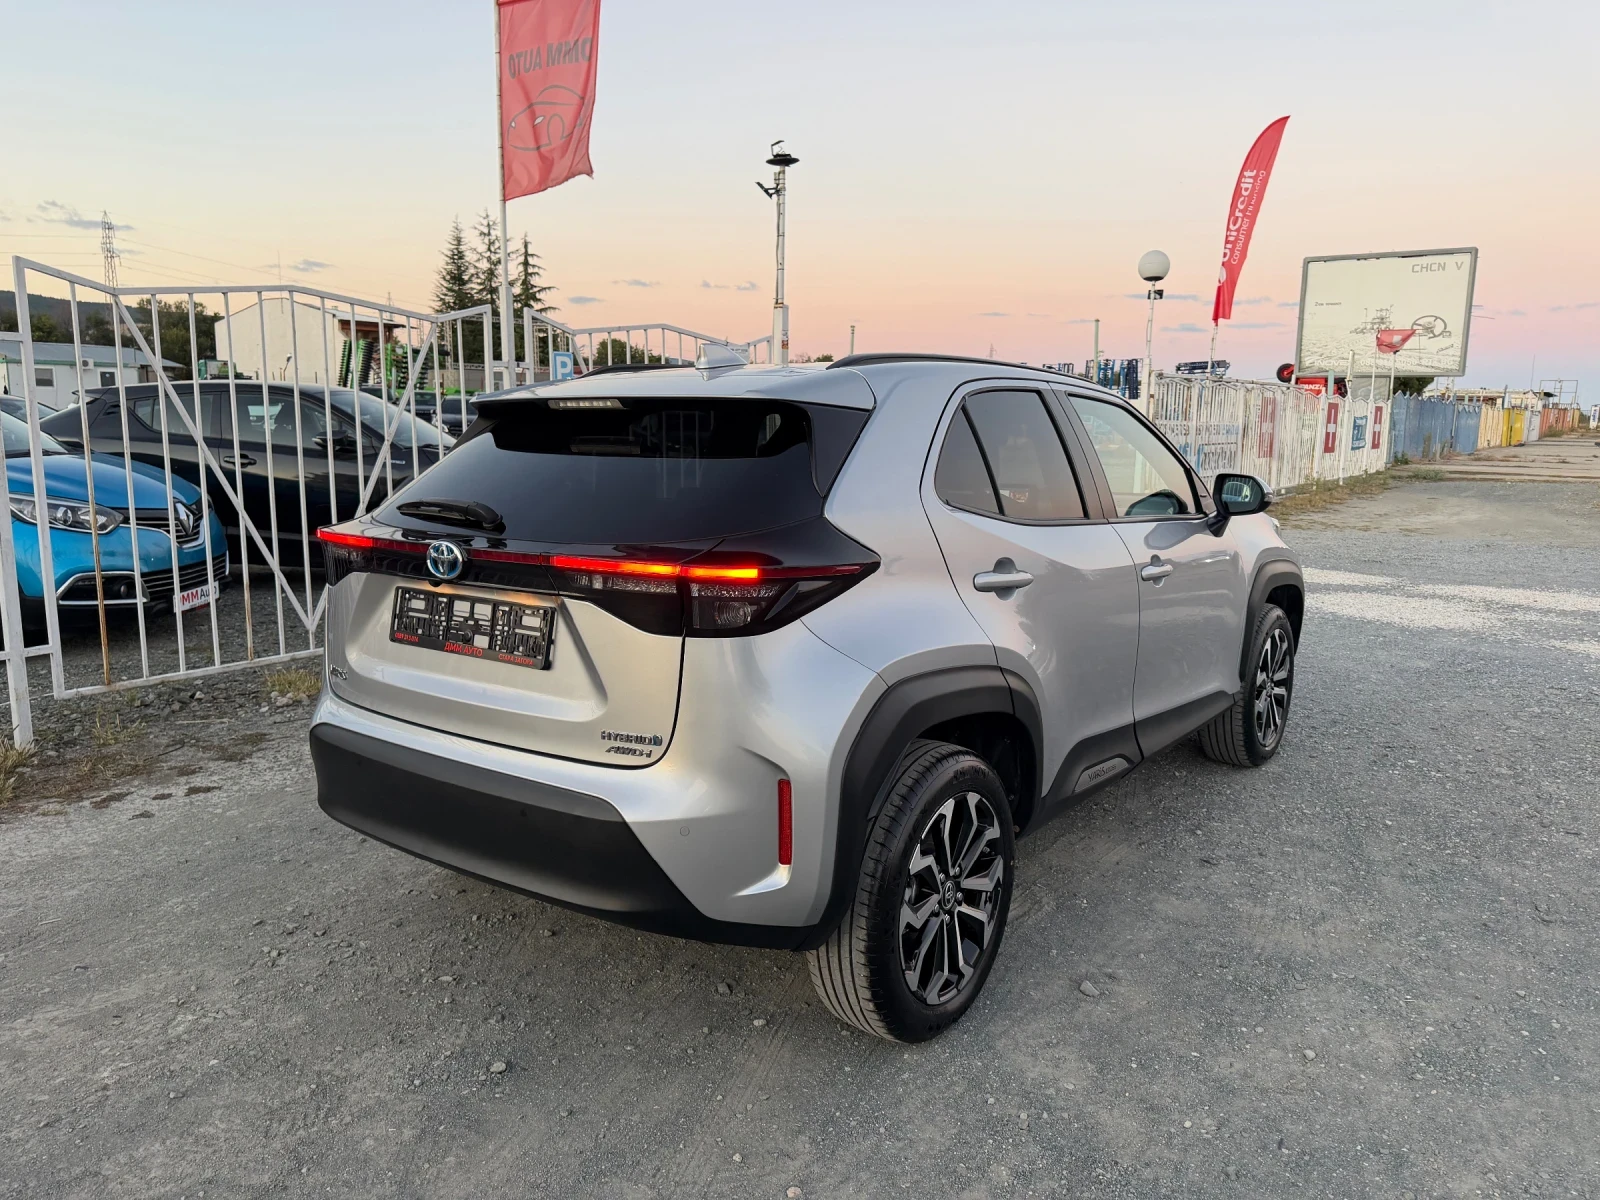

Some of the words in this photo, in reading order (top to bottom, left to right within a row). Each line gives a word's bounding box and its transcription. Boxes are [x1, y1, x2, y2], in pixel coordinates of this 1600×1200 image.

[556, 356, 572, 380] P
[444, 642, 463, 653] ДММ
[463, 645, 483, 657] АУТО
[600, 730, 653, 746] HYBRID
